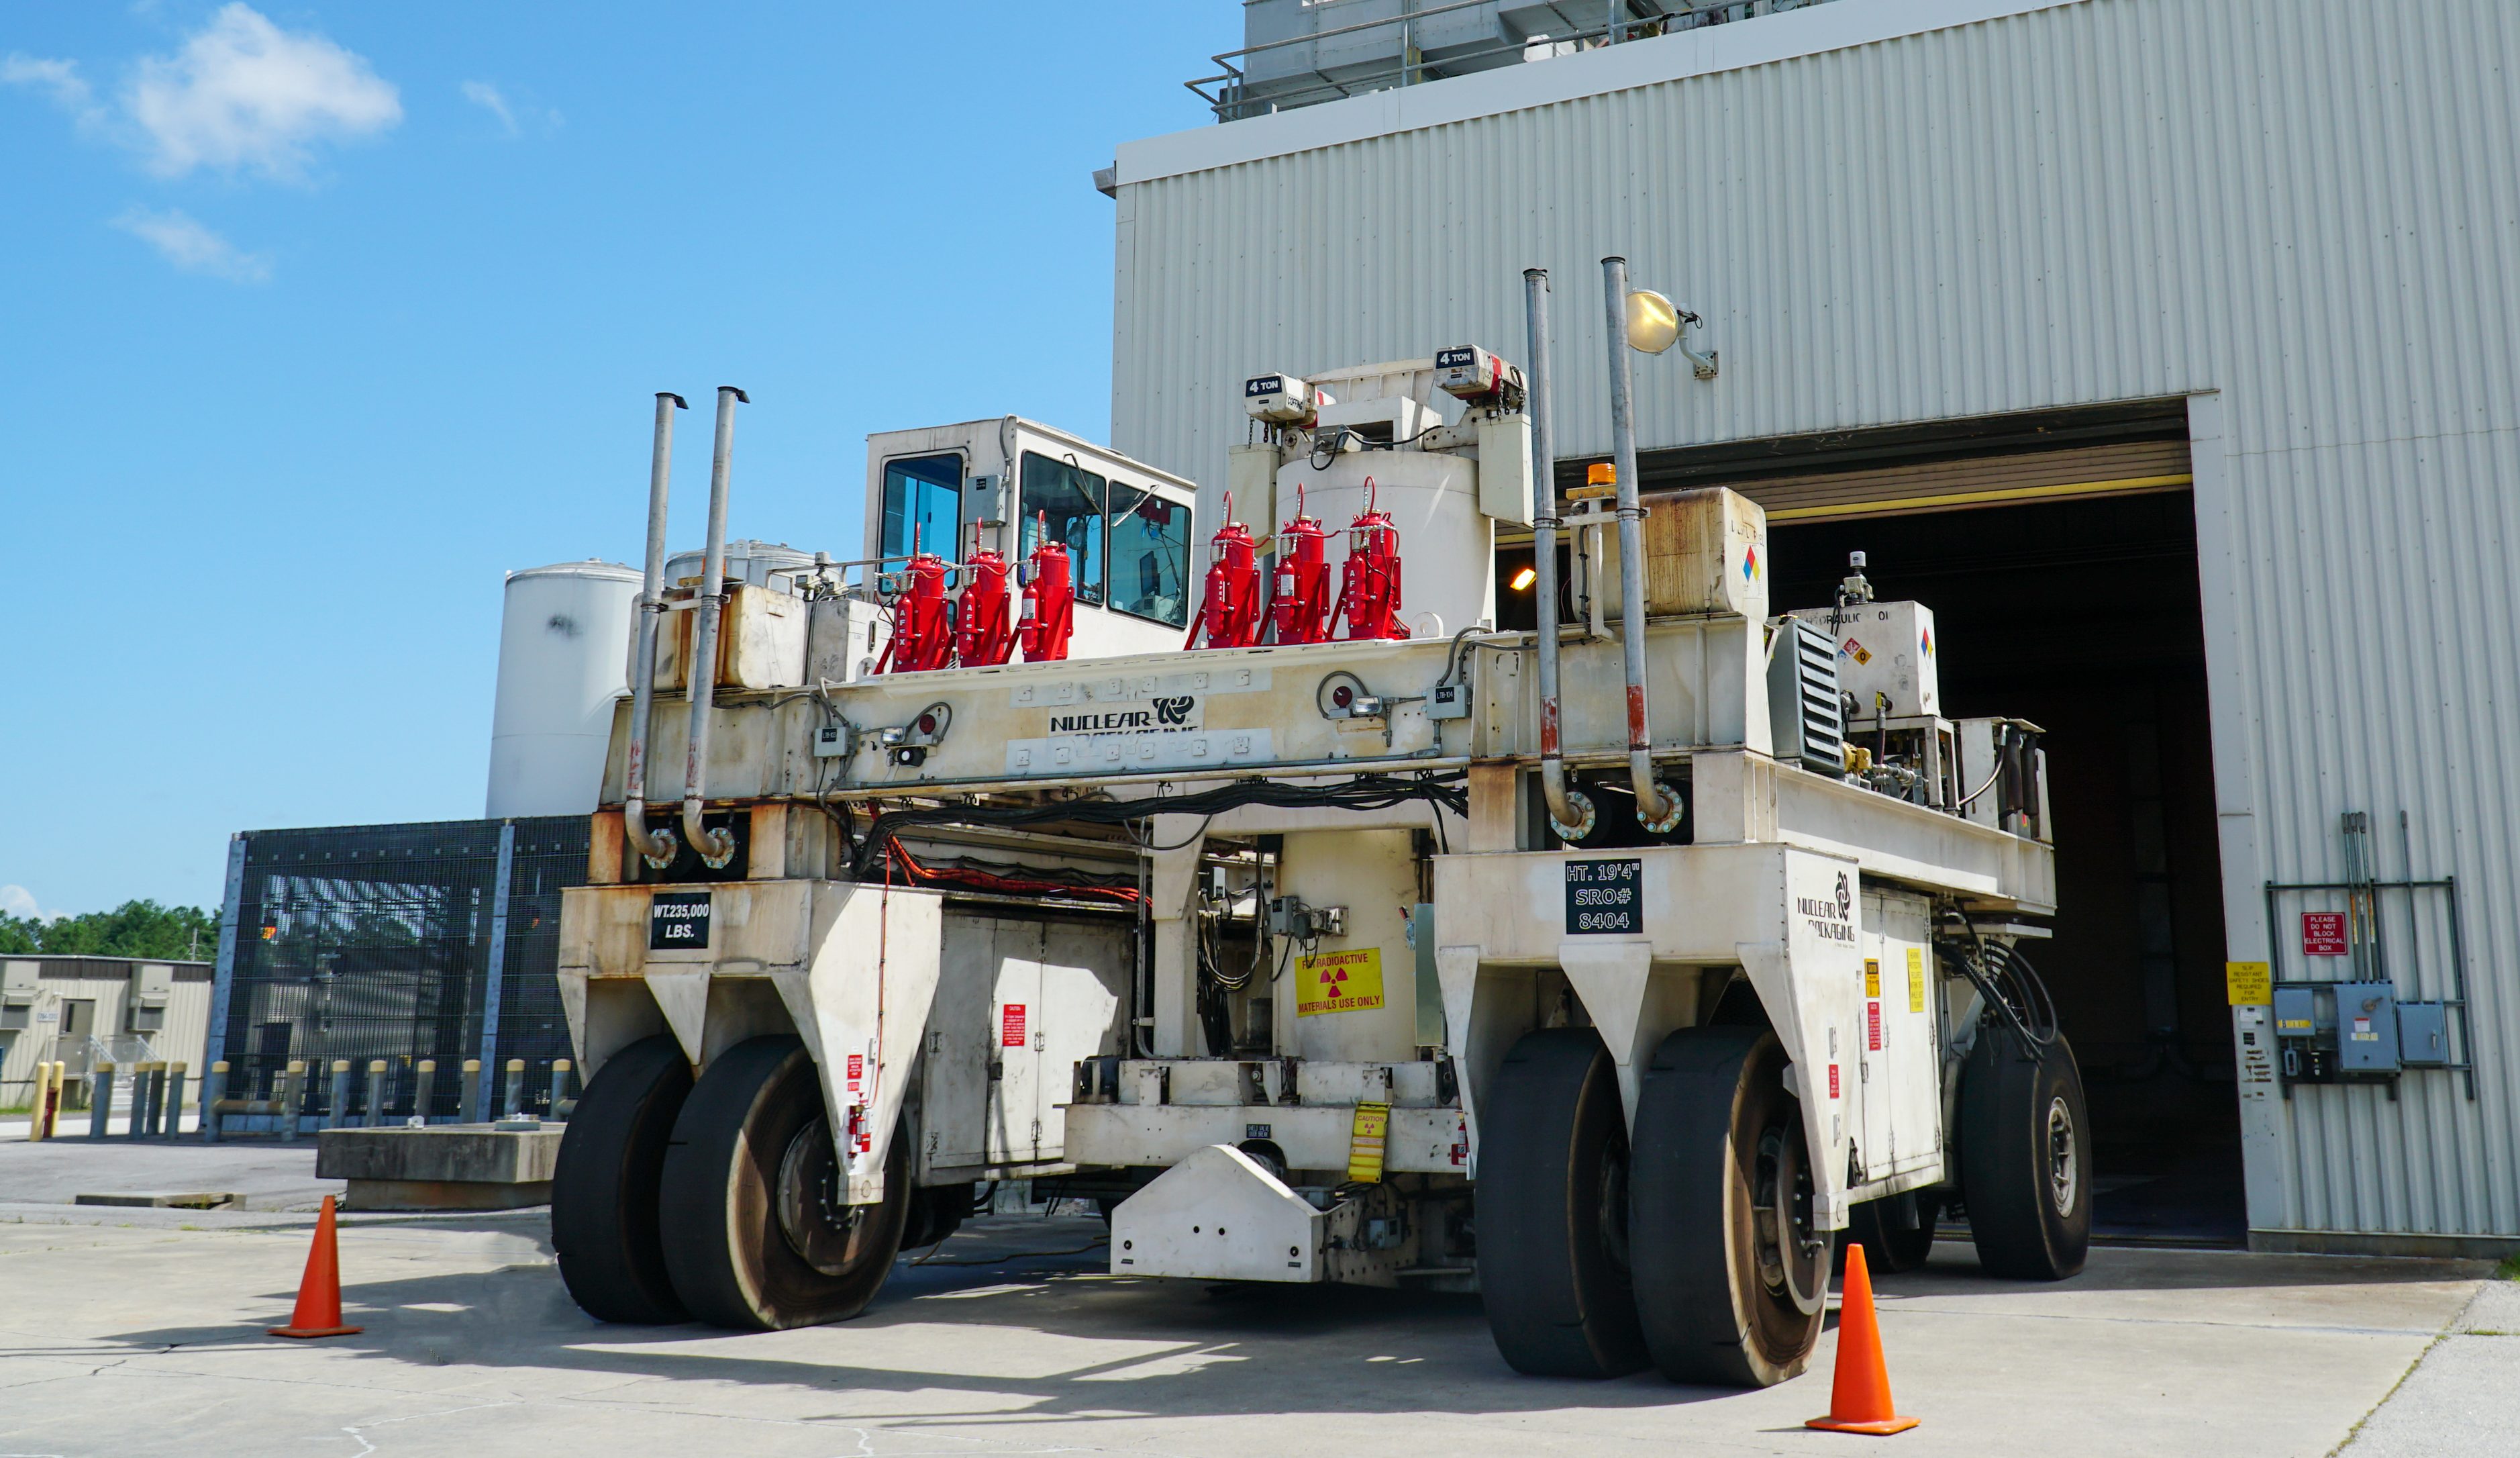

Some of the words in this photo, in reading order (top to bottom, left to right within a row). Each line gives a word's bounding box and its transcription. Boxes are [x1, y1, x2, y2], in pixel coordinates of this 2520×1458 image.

[1440, 353, 1450, 364] 4
[1452, 352, 1471, 362] TON
[1250, 381, 1259, 393] 4
[1260, 381, 1279, 390] TON
[1860, 652, 1866, 661] 0
[1050, 712, 1152, 732] NUCLEAR
[1567, 865, 1593, 881] HT.
[1598, 863, 1640, 881] 19'4"
[1576, 888, 1631, 905] SRO#
[654, 904, 709, 920] WT.235,000
[1797, 896, 1836, 919] NUCLEAR
[1579, 912, 1629, 930] 8404
[665, 924, 695, 938] LBS.
[1317, 953, 1368, 968] RADIOACTIVE
[1299, 1000, 1337, 1013] MATERIALS
[1339, 998, 1355, 1008] USE
[1357, 995, 1380, 1006] ONLY
